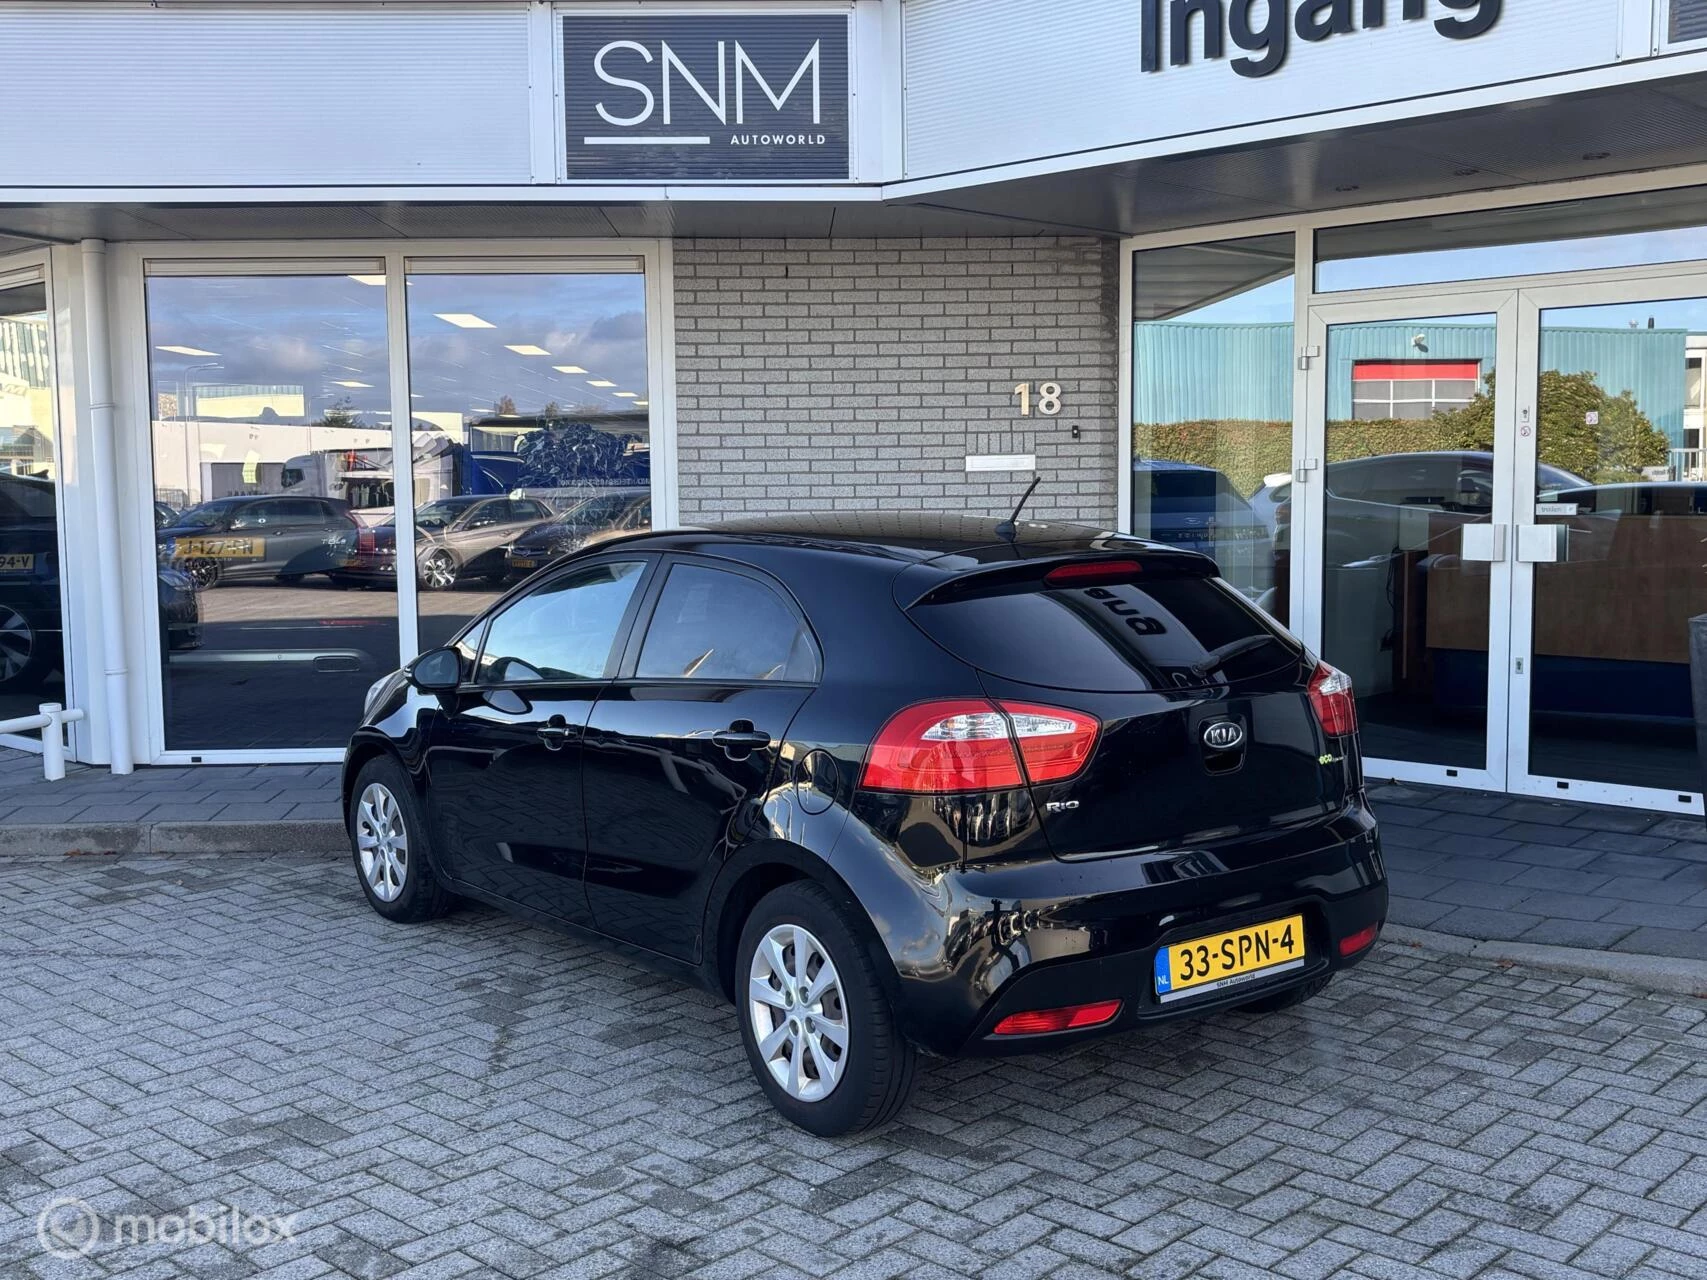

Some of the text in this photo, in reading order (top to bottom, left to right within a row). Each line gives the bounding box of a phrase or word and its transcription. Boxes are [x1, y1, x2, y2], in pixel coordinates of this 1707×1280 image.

[594, 38, 820, 126] SNM
[730, 134, 826, 145] AUTOWORLD
[1014, 382, 1062, 416] 18
[1210, 727, 1237, 744] KIA
[1180, 924, 1294, 981] 33-SPN-4
[1157, 975, 1169, 986] NL
